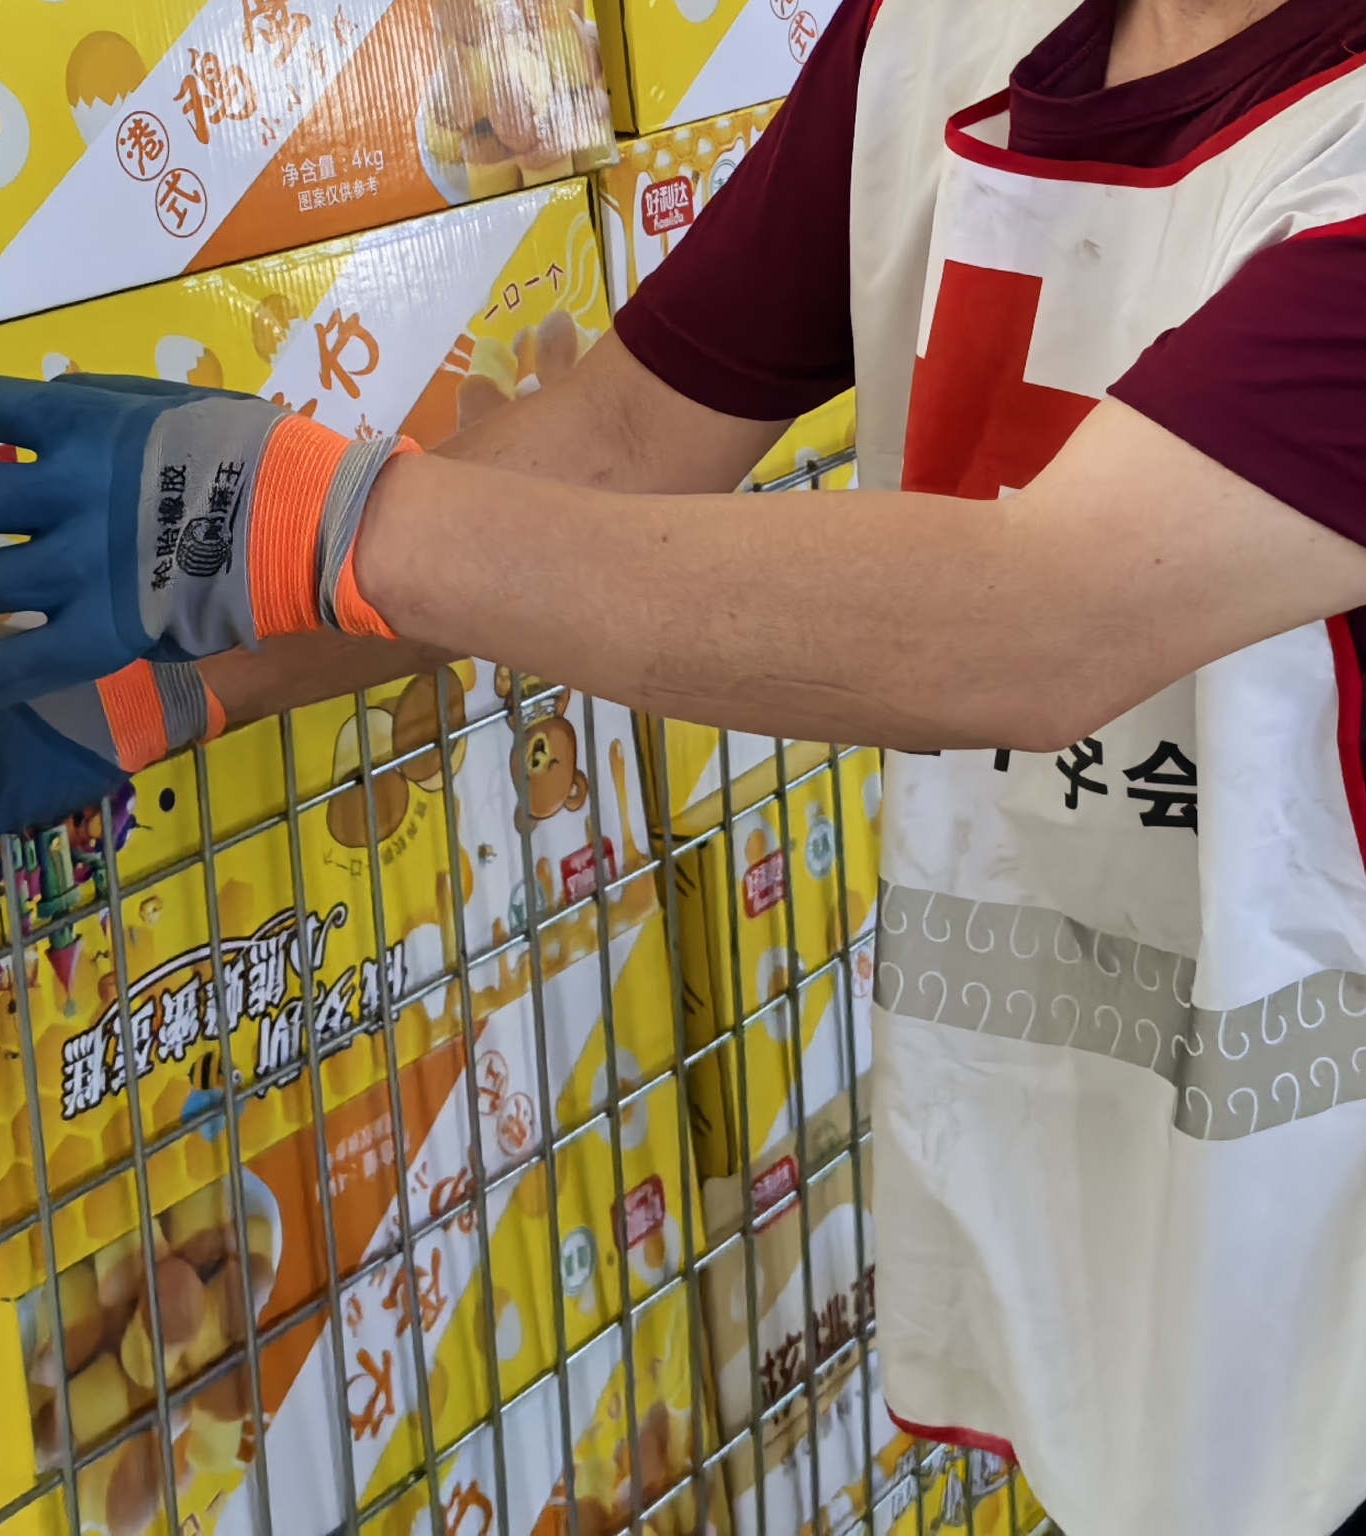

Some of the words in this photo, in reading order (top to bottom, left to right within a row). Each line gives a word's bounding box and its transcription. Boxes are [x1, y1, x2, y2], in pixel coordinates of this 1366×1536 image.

[119, 114, 206, 235] 港式
[295, 175, 381, 214] 图案仅供参考
[645, 180, 690, 218] 好利达
